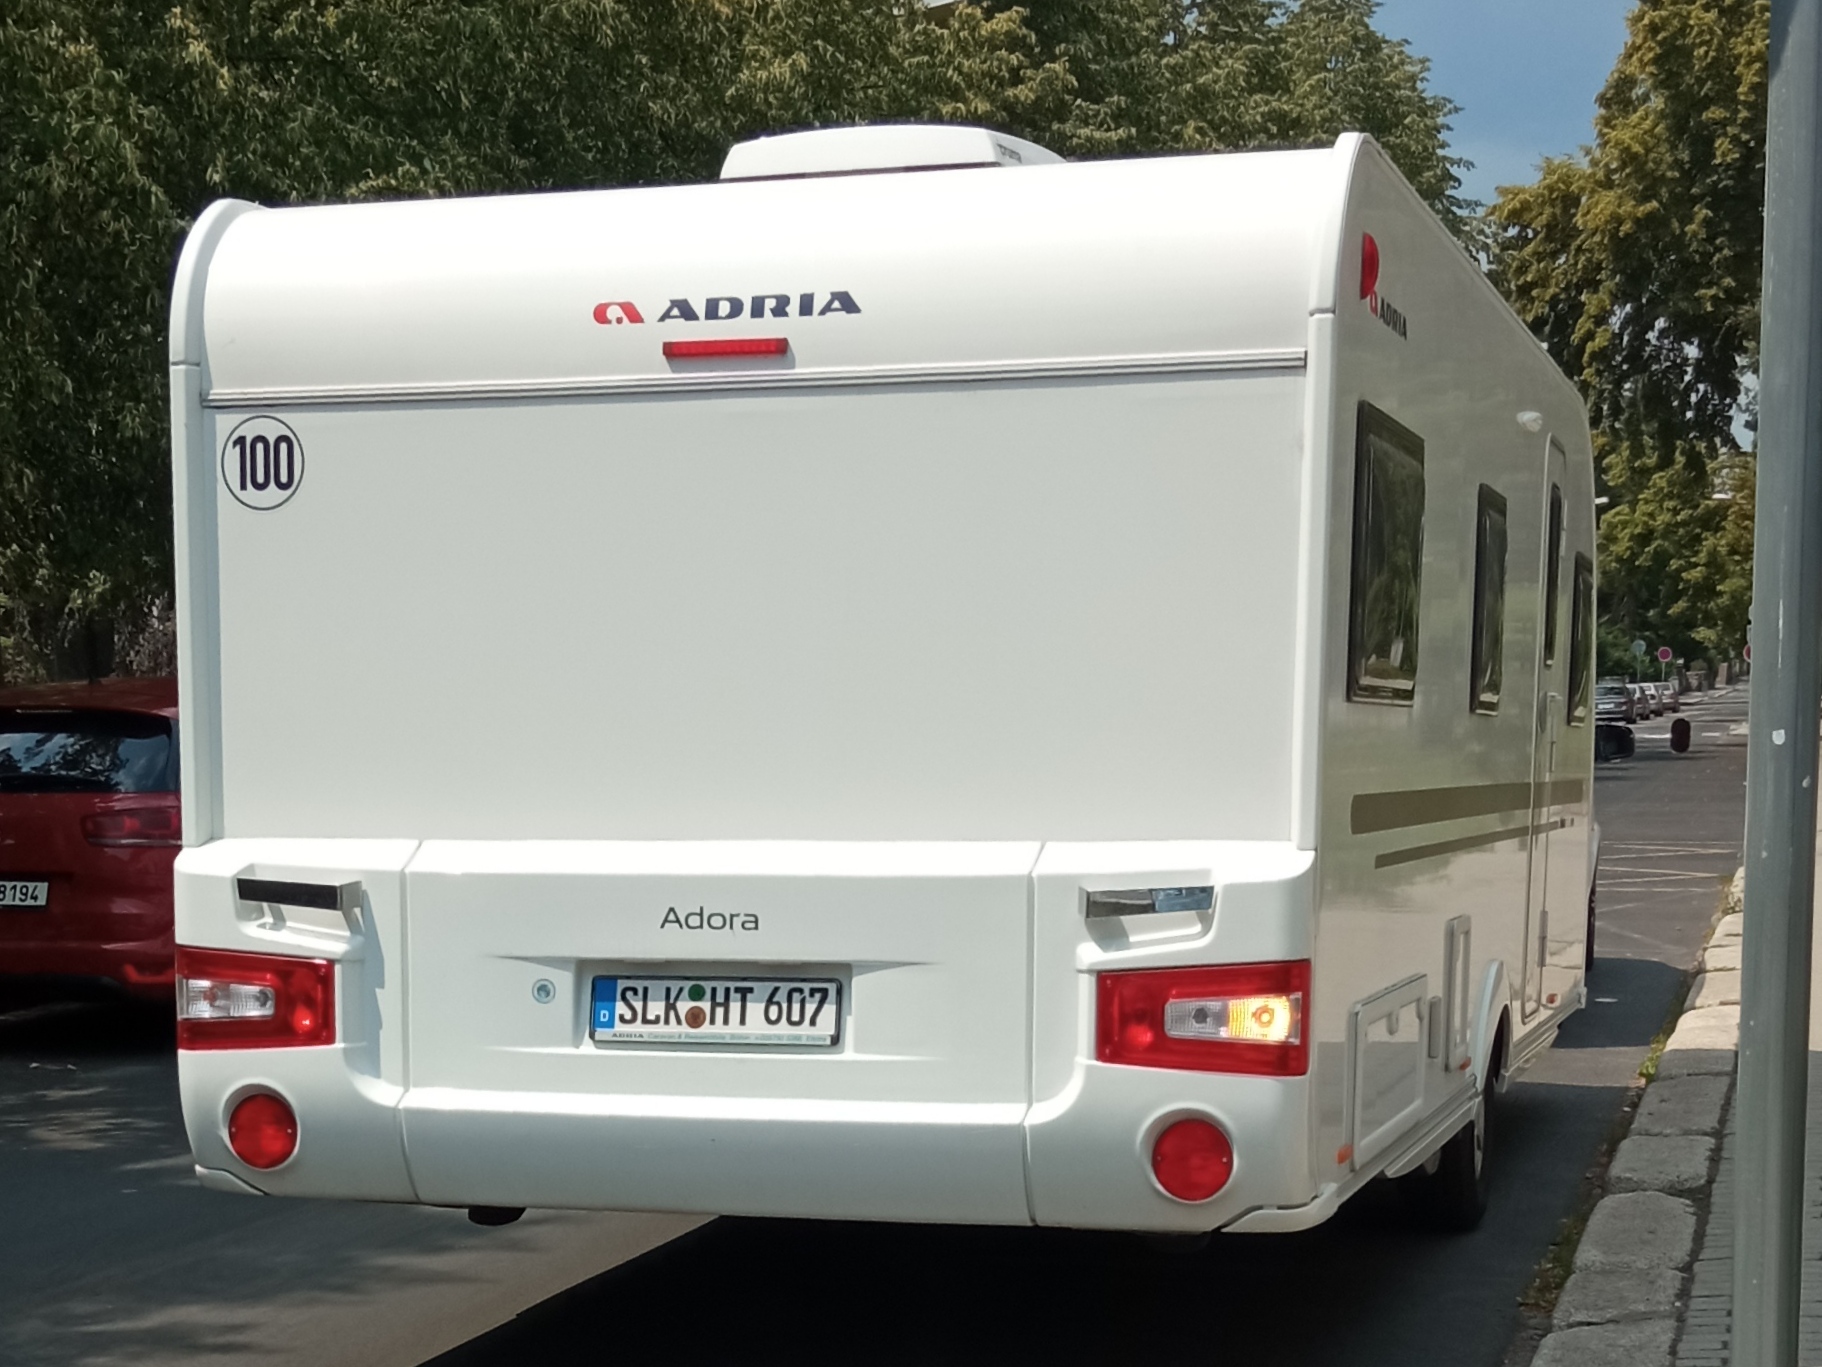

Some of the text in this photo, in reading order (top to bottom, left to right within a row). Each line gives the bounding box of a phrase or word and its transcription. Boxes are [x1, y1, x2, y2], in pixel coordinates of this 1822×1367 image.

[657, 290, 862, 323] ADRIA
[1380, 296, 1407, 341] ADRIA
[232, 434, 295, 492] 100
[660, 905, 759, 931] Adora
[600, 986, 829, 1027] D SLK HT 607
